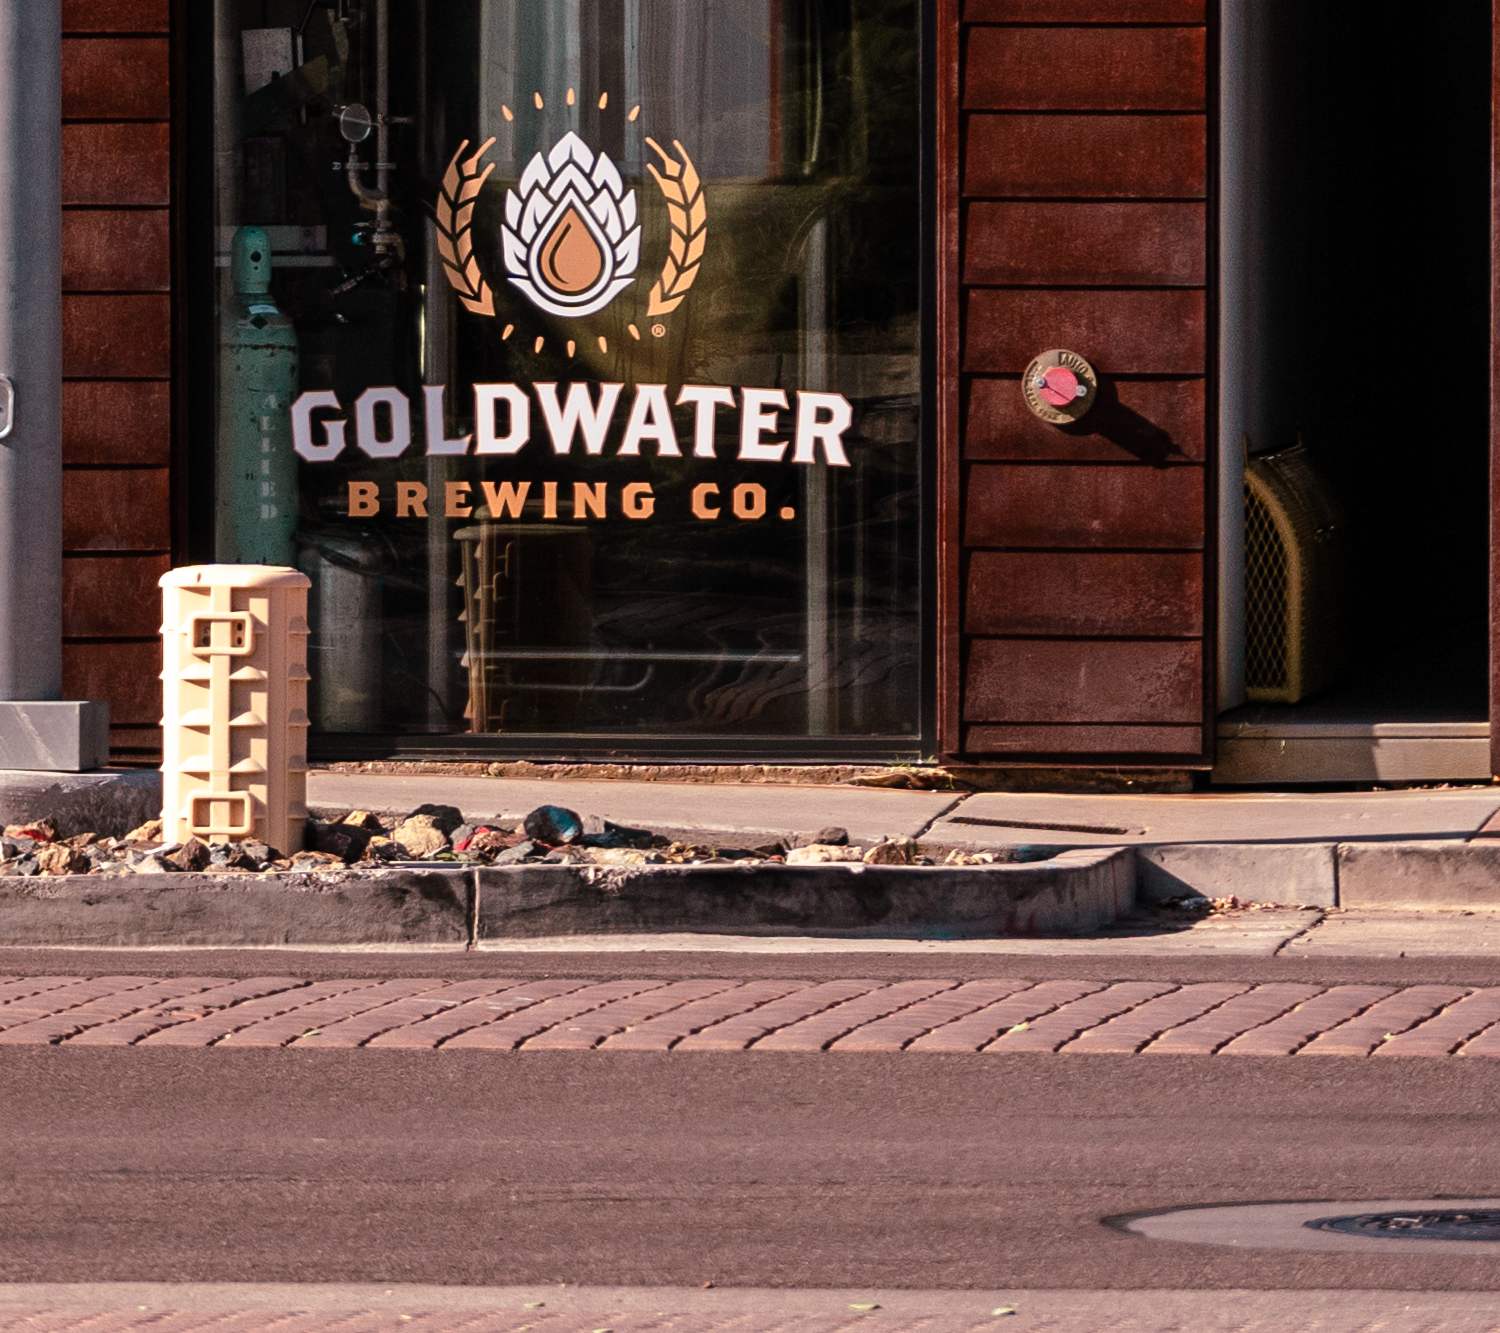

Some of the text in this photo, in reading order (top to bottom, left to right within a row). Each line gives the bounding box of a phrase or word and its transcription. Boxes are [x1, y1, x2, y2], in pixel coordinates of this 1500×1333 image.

[290, 381, 853, 468] GOLDWATER
[347, 480, 796, 521] BREWING CO.
